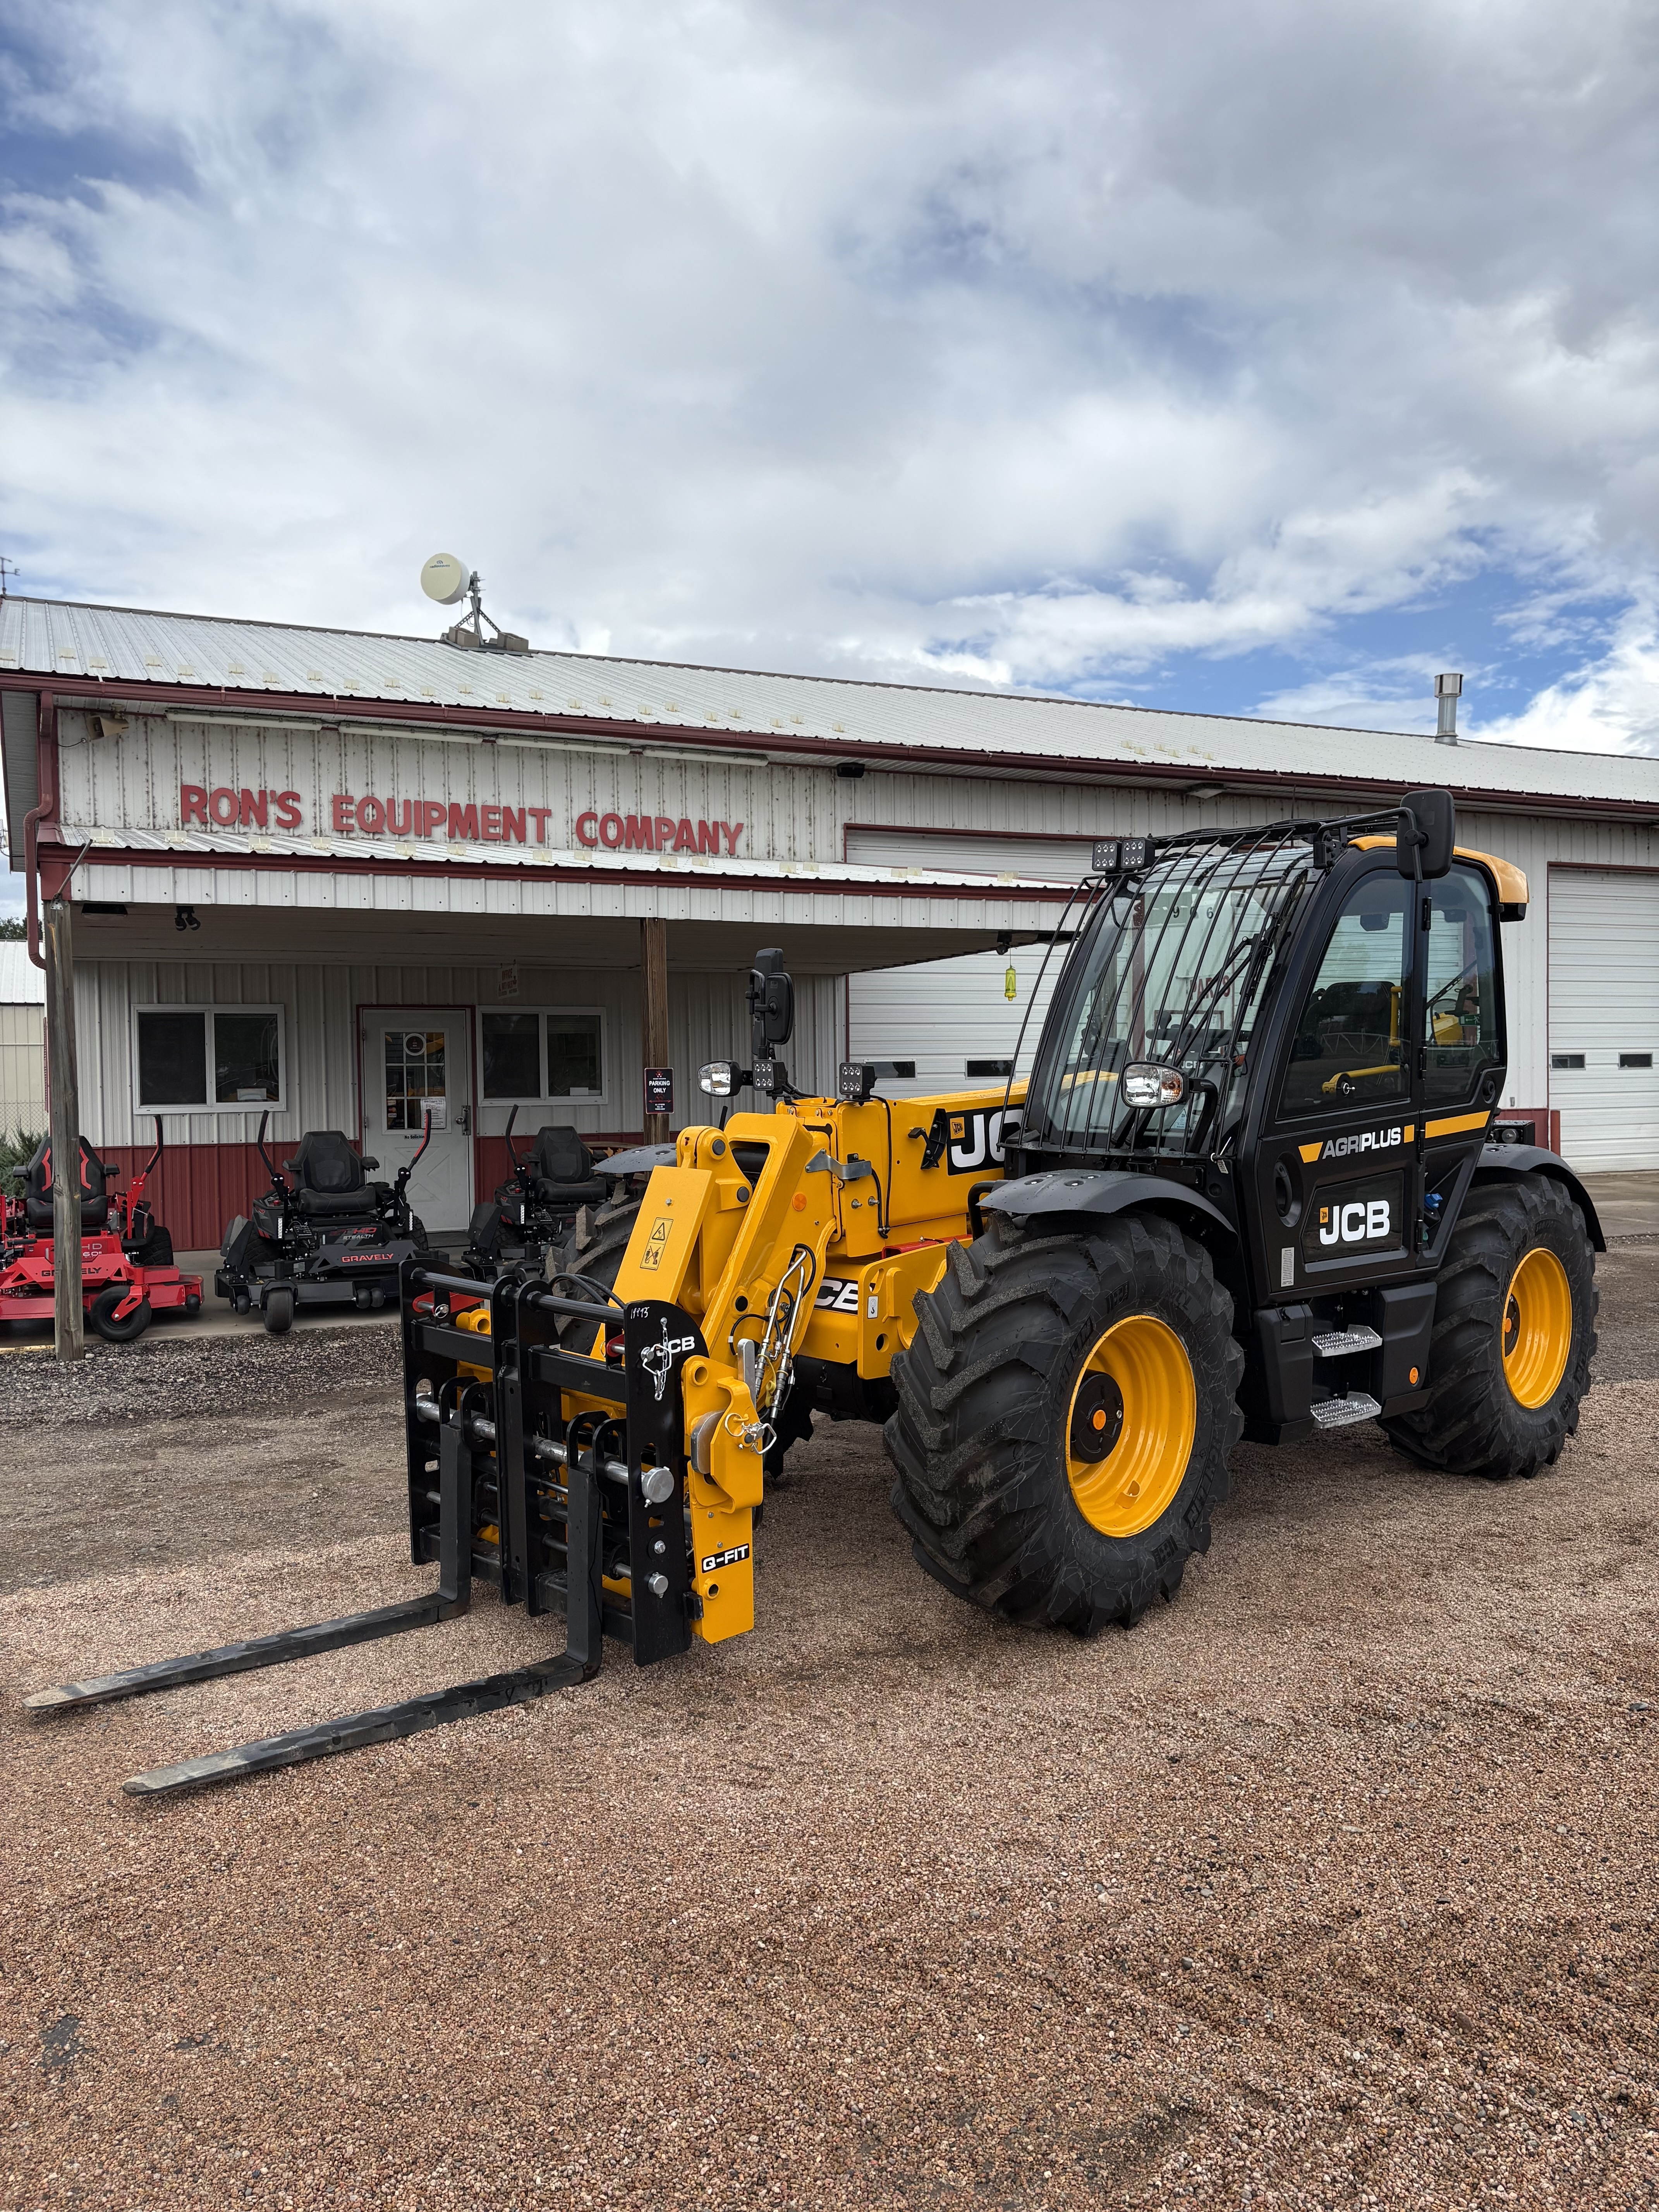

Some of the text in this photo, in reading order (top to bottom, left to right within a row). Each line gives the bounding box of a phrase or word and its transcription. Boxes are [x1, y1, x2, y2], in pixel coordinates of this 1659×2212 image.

[181, 785, 744, 855] RON'S EQUIPMENT COMPANY
[1190, 975, 1230, 1000] PARS
[951, 1109, 1024, 1168] JC
[1322, 1127, 1401, 1159] AGRIPLUS
[1320, 1200, 1390, 1245] JCB
[41, 1267, 102, 1277] GELY
[342, 1253, 394, 1262] GRAVELY
[814, 1279, 858, 1311] CB
[703, 1545, 748, 1571] Q-FIT
